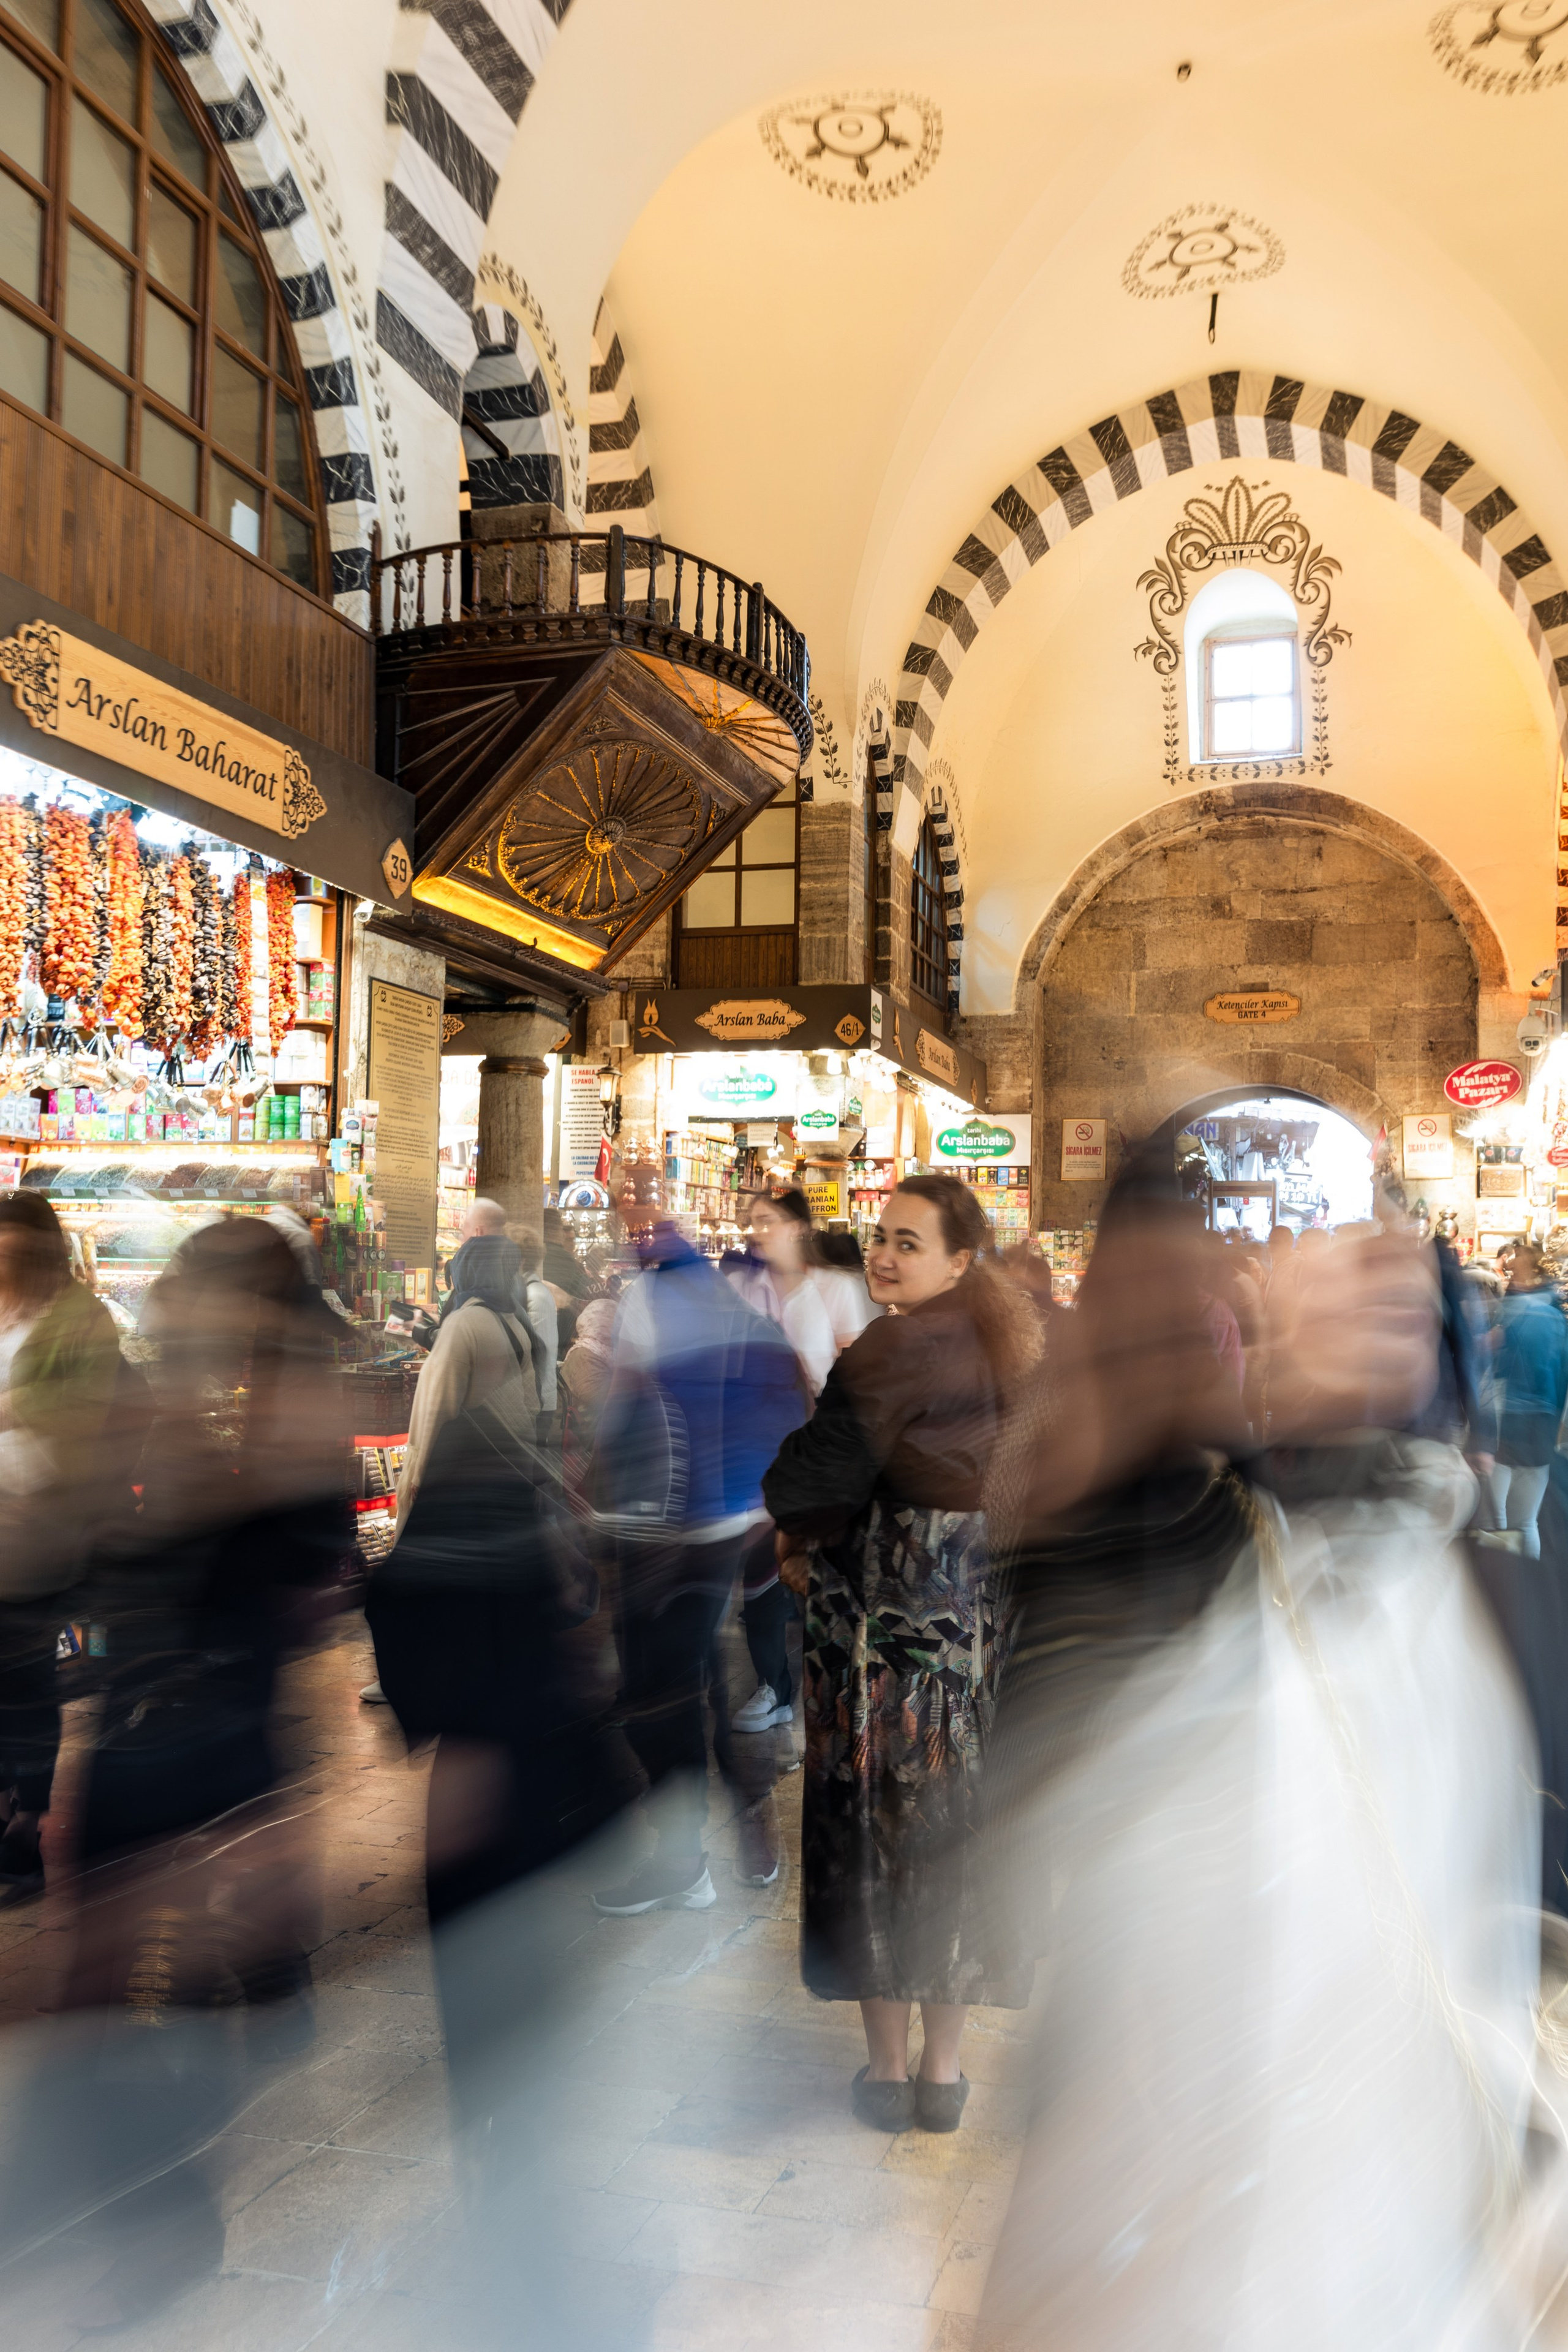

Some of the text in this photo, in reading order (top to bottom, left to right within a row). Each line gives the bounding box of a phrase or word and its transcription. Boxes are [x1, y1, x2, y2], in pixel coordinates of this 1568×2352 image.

[66, 677, 278, 801] Arslan Baharat
[391, 854, 407, 883] 39
[1216, 999, 1288, 1011] Ketenciler Kapısı
[714, 1011, 786, 1027] Arslan Baba
[840, 1022, 859, 1036] 46/1
[1452, 1073, 1510, 1088] Malatya
[1458, 1085, 1508, 1099] Pazarı
[941, 1134, 1010, 1147] Arslanbaba
[1066, 1145, 1102, 1157] SİGARA İÇİLMEZ
